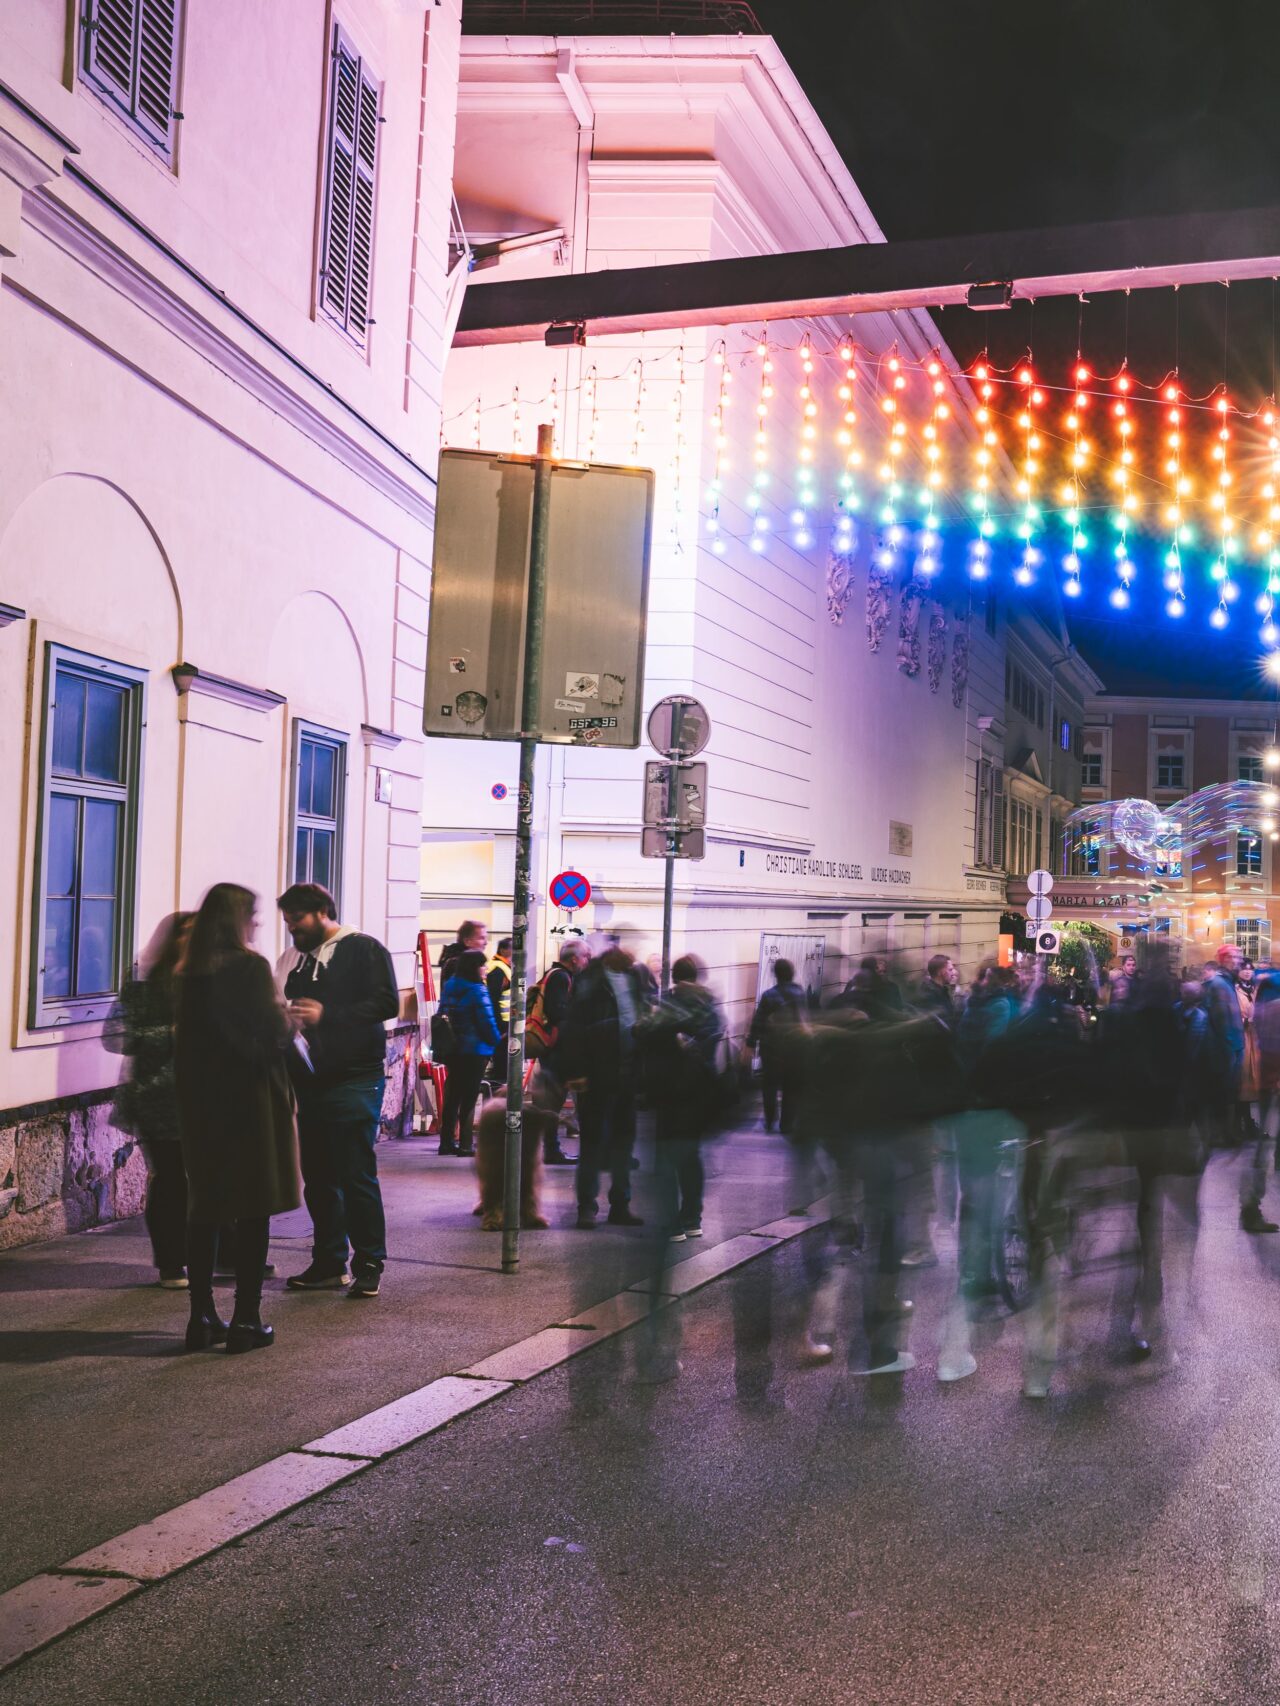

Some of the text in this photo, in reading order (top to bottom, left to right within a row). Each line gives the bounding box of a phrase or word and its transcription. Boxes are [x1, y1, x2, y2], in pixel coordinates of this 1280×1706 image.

[570, 717, 616, 729] GSF 96
[766, 853, 864, 880] CHRISTIANE KAROLINE SCHLEGEL
[1052, 896, 1129, 906] MARIA LAZAR
[1044, 937, 1051, 945] 8
